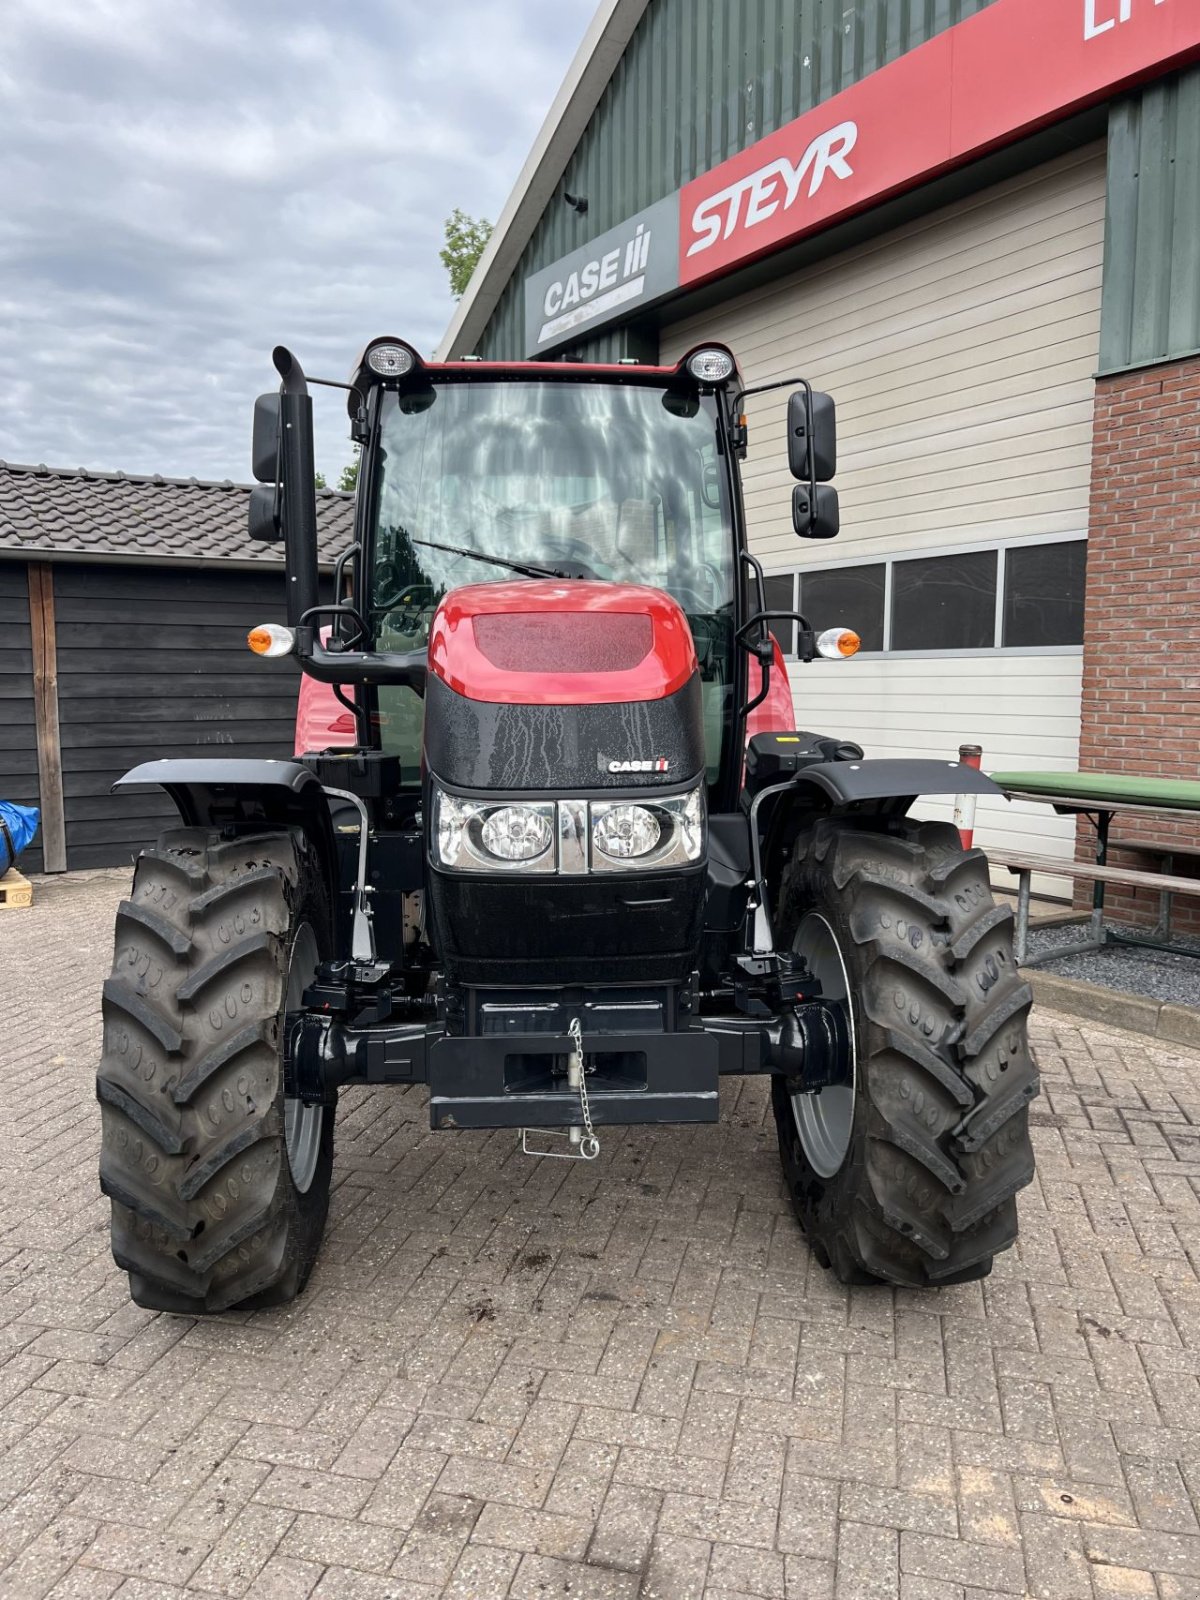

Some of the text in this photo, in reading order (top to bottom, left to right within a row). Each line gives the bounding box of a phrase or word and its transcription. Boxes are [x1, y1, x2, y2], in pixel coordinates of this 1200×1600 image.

[686, 121, 858, 257] STEYR
[544, 247, 621, 317] CASE
[608, 760, 653, 773] CASE
